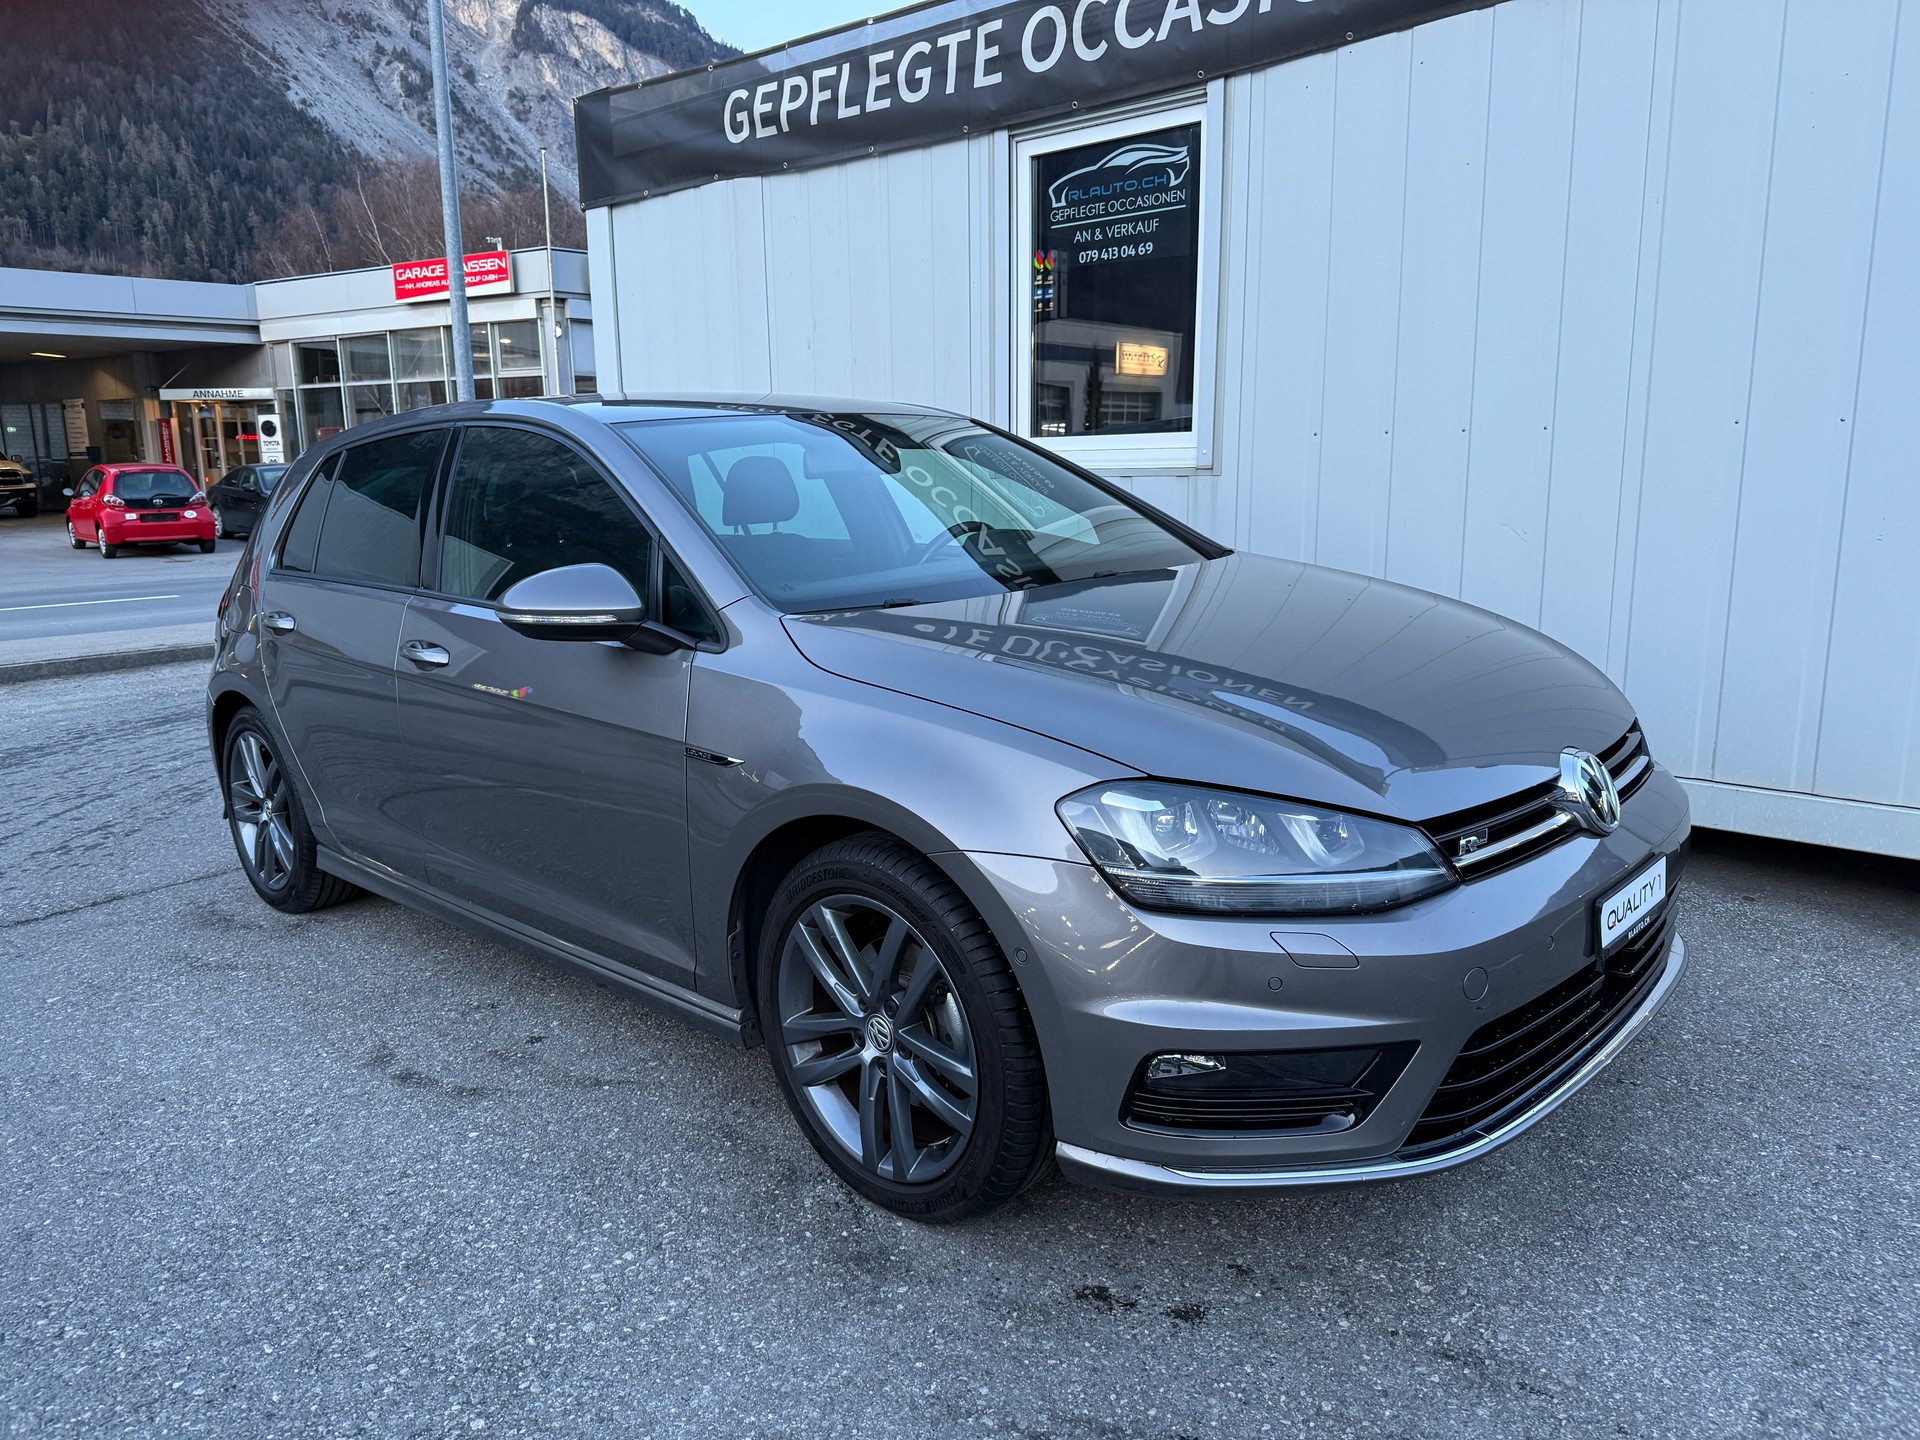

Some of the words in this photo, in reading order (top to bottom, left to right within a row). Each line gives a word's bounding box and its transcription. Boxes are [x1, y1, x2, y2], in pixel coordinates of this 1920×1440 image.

[724, 19, 1003, 143] GEPFLEGTE
[1021, 0, 1313, 73] OCCA
[1068, 174, 1167, 201] RLAUTO.CH
[1050, 202, 1106, 222] GEPFLEGTE
[1107, 189, 1186, 213] OCCASIONEN
[1073, 229, 1091, 243] AN
[1094, 229, 1103, 240] &
[1106, 219, 1160, 238] VERKAUF
[1078, 250, 1099, 264] 079
[1100, 247, 1119, 260] 413
[1120, 244, 1136, 258] 04
[1138, 242, 1153, 255] 69
[396, 264, 445, 281] GARAGE
[463, 257, 506, 273] AISSEN
[415, 279, 441, 289] ANDREAS
[192, 389, 245, 399] ANNAHME
[262, 439, 281, 448] TOYOTA
[1606, 876, 1656, 931] QUALITY
[1657, 873, 1662, 891] 1
[1628, 915, 1651, 940] RLAUTO.CH
